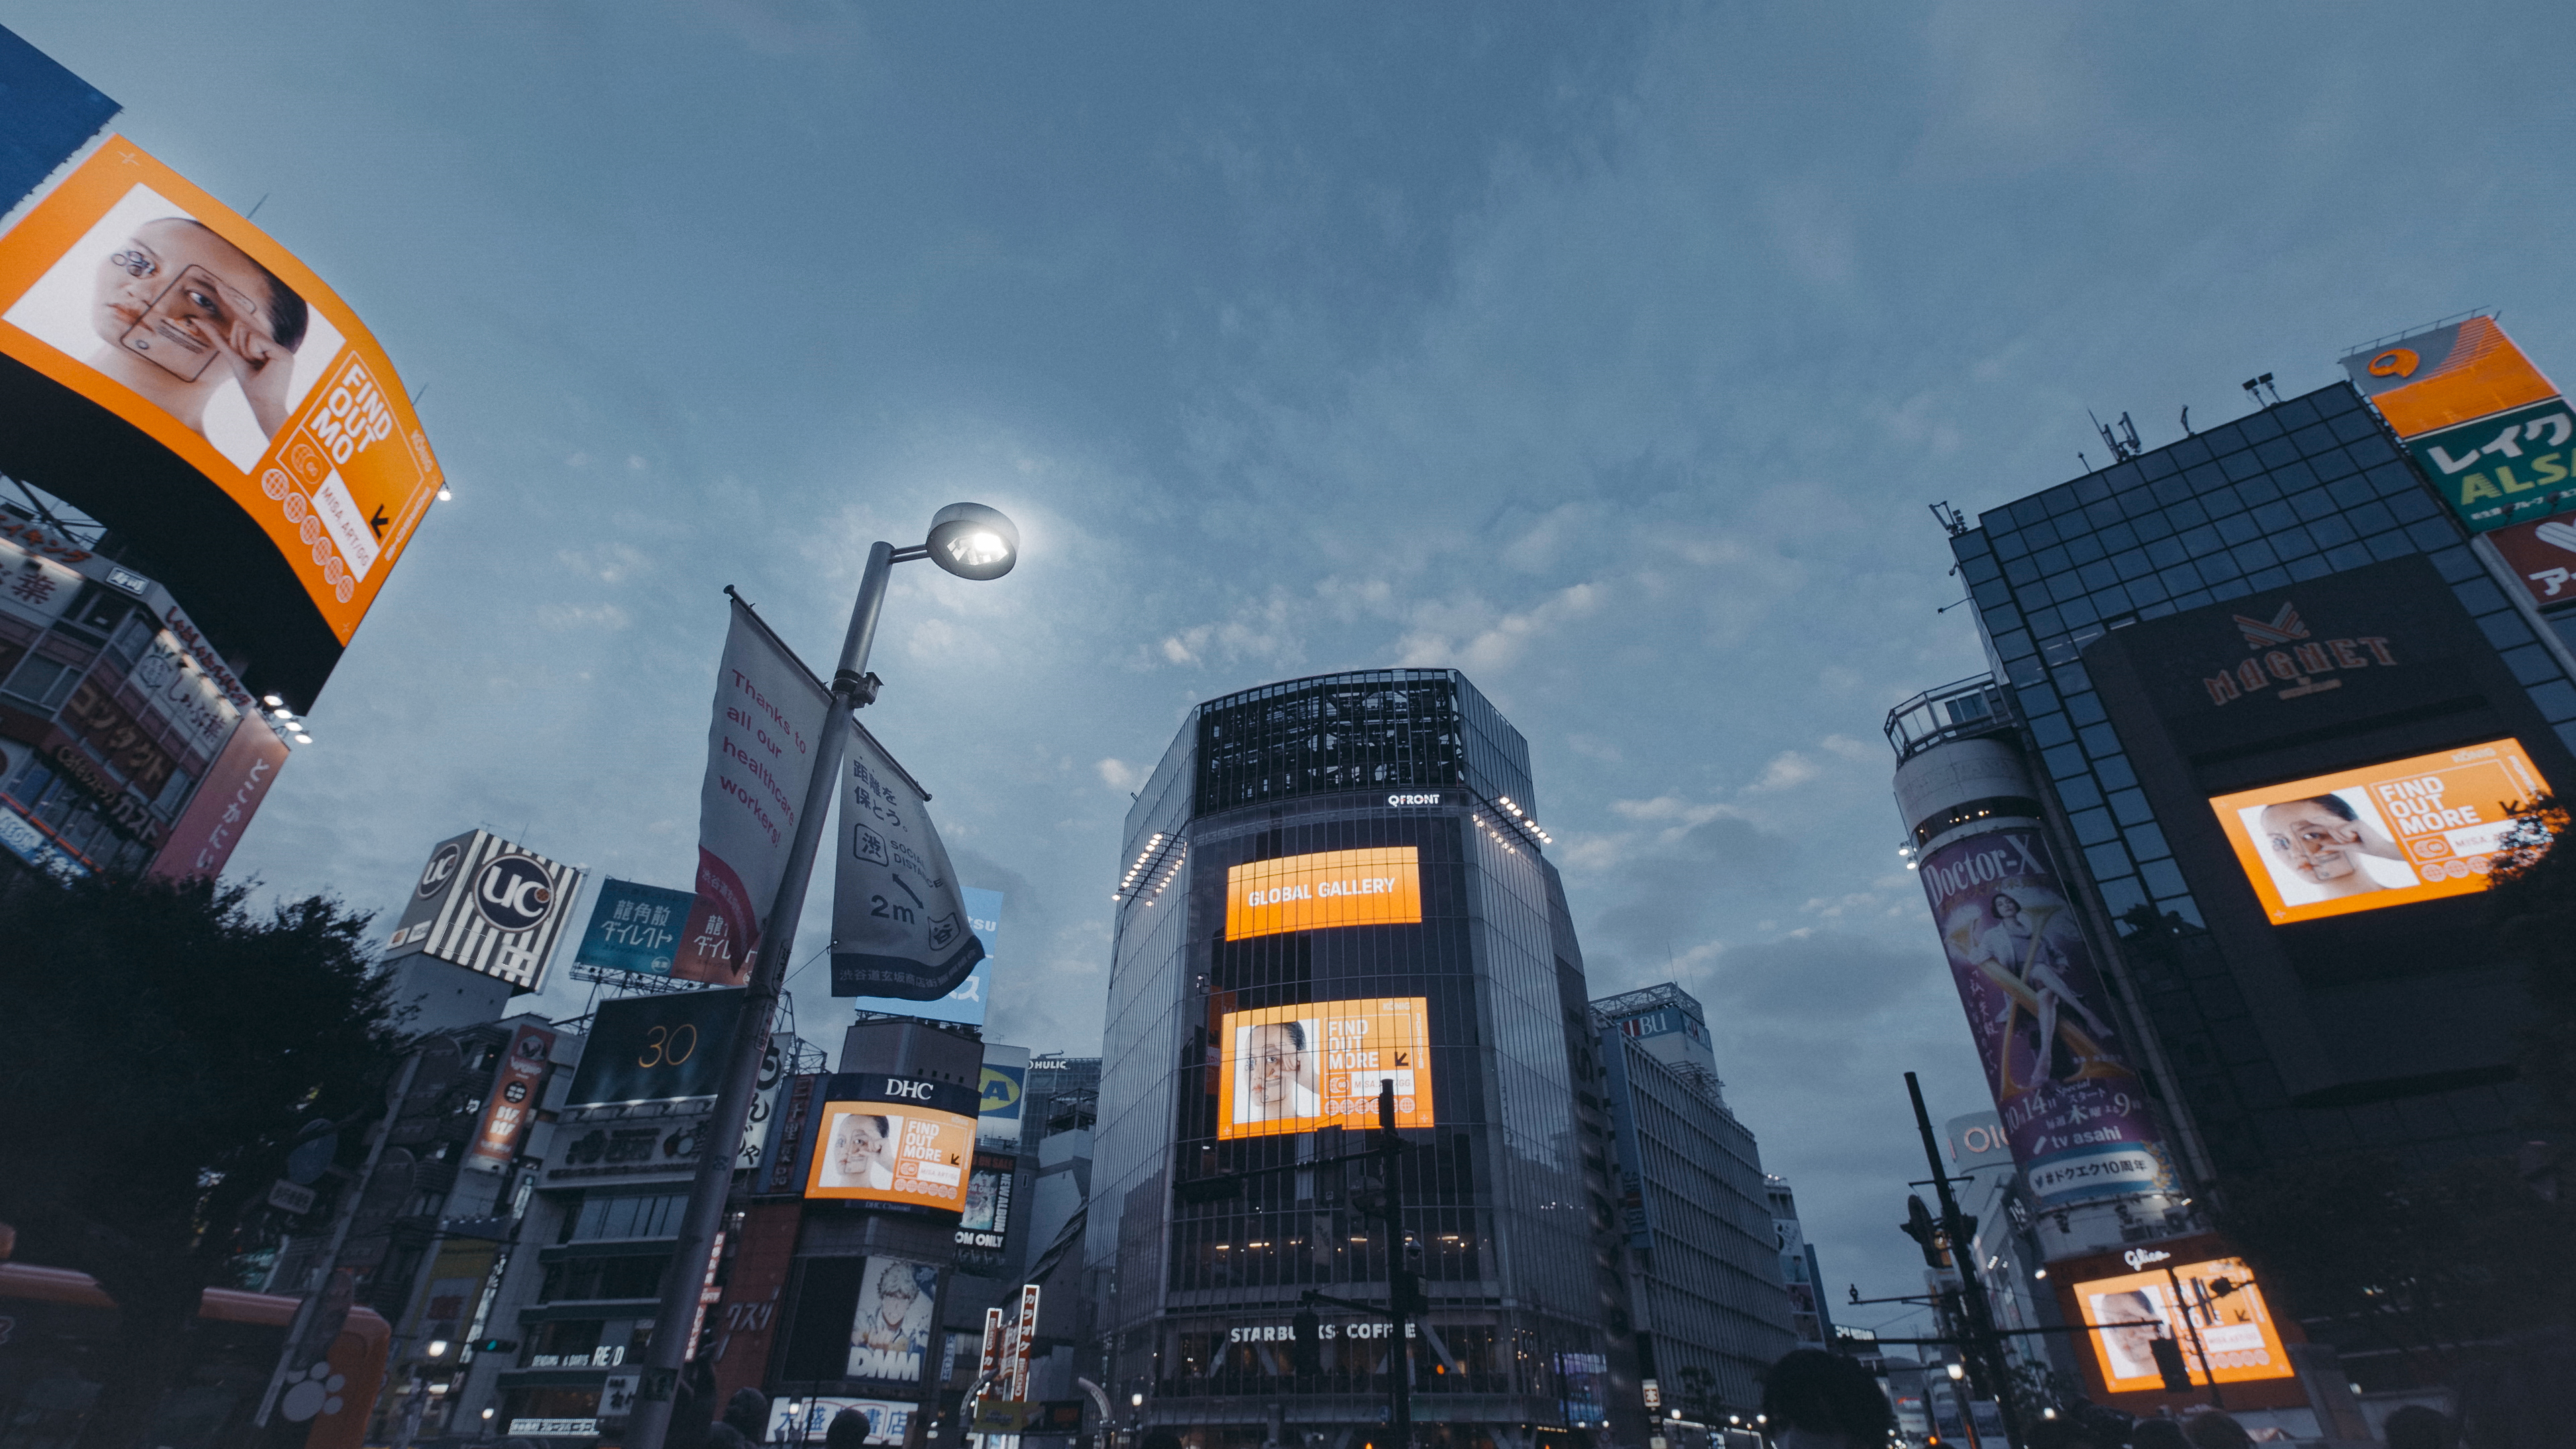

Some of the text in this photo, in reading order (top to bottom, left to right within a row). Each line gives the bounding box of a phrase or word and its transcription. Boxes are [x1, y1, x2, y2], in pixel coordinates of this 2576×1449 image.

[342, 364, 392, 440] FIND
[328, 386, 376, 453] OUT
[310, 407, 354, 464] MO
[2426, 413, 2572, 474] レイク
[2203, 637, 2398, 706] MAGNET
[732, 668, 806, 754] Thanks to
[70, 682, 164, 782] コンタクト
[727, 706, 782, 759] all our
[722, 735, 794, 826] healthcare
[853, 759, 898, 806] 距離を
[2379, 776, 2445, 802] FIND
[720, 775, 782, 848] workers!
[855, 786, 908, 833] 保とう。
[1388, 794, 1440, 807] QFRONT
[2388, 794, 2444, 818] OUT
[2398, 806, 2481, 836] MORE
[862, 833, 881, 858] 渋
[890, 841, 926, 871] SOCIAL
[894, 853, 943, 888] DISTANCE
[1922, 835, 2048, 908] Doctor-X
[1248, 877, 1395, 907] GLOBAL GALLERY
[613, 899, 671, 926] 龍角散
[871, 894, 915, 924] 2m
[600, 920, 673, 949] ダイレクト
[705, 914, 729, 936] 龍
[694, 935, 757, 963] ダイレト
[1383, 1000, 1411, 1011] KÖNIG
[1328, 1019, 1368, 1036] FIND
[1626, 1013, 1667, 1037] IBU
[638, 1024, 697, 1068] 30
[1328, 1035, 1363, 1054] OUT
[1034, 1061, 1067, 1069] HULIC
[1329, 1051, 1379, 1070] MORE
[885, 1079, 933, 1099] DHC
[906, 1132, 934, 1148] OUT
[908, 1121, 939, 1136] FIND
[2051, 1126, 2123, 1148] tv asahi
[903, 1146, 942, 1162] MORE
[1566, 1006, 1630, 1339] TSUTAYA
[994, 1173, 1012, 1232] NEW ALBUM
[975, 1234, 1004, 1248] ONLY
[2125, 1248, 2170, 1271] Glico
[727, 1300, 776, 1332] クスリ
[1020, 1293, 1036, 1351] カラオケ
[1231, 1323, 1415, 1342] STARBUKS COFFE
[847, 1346, 920, 1382] DMM
[776, 1406, 908, 1436] 大盛書店
